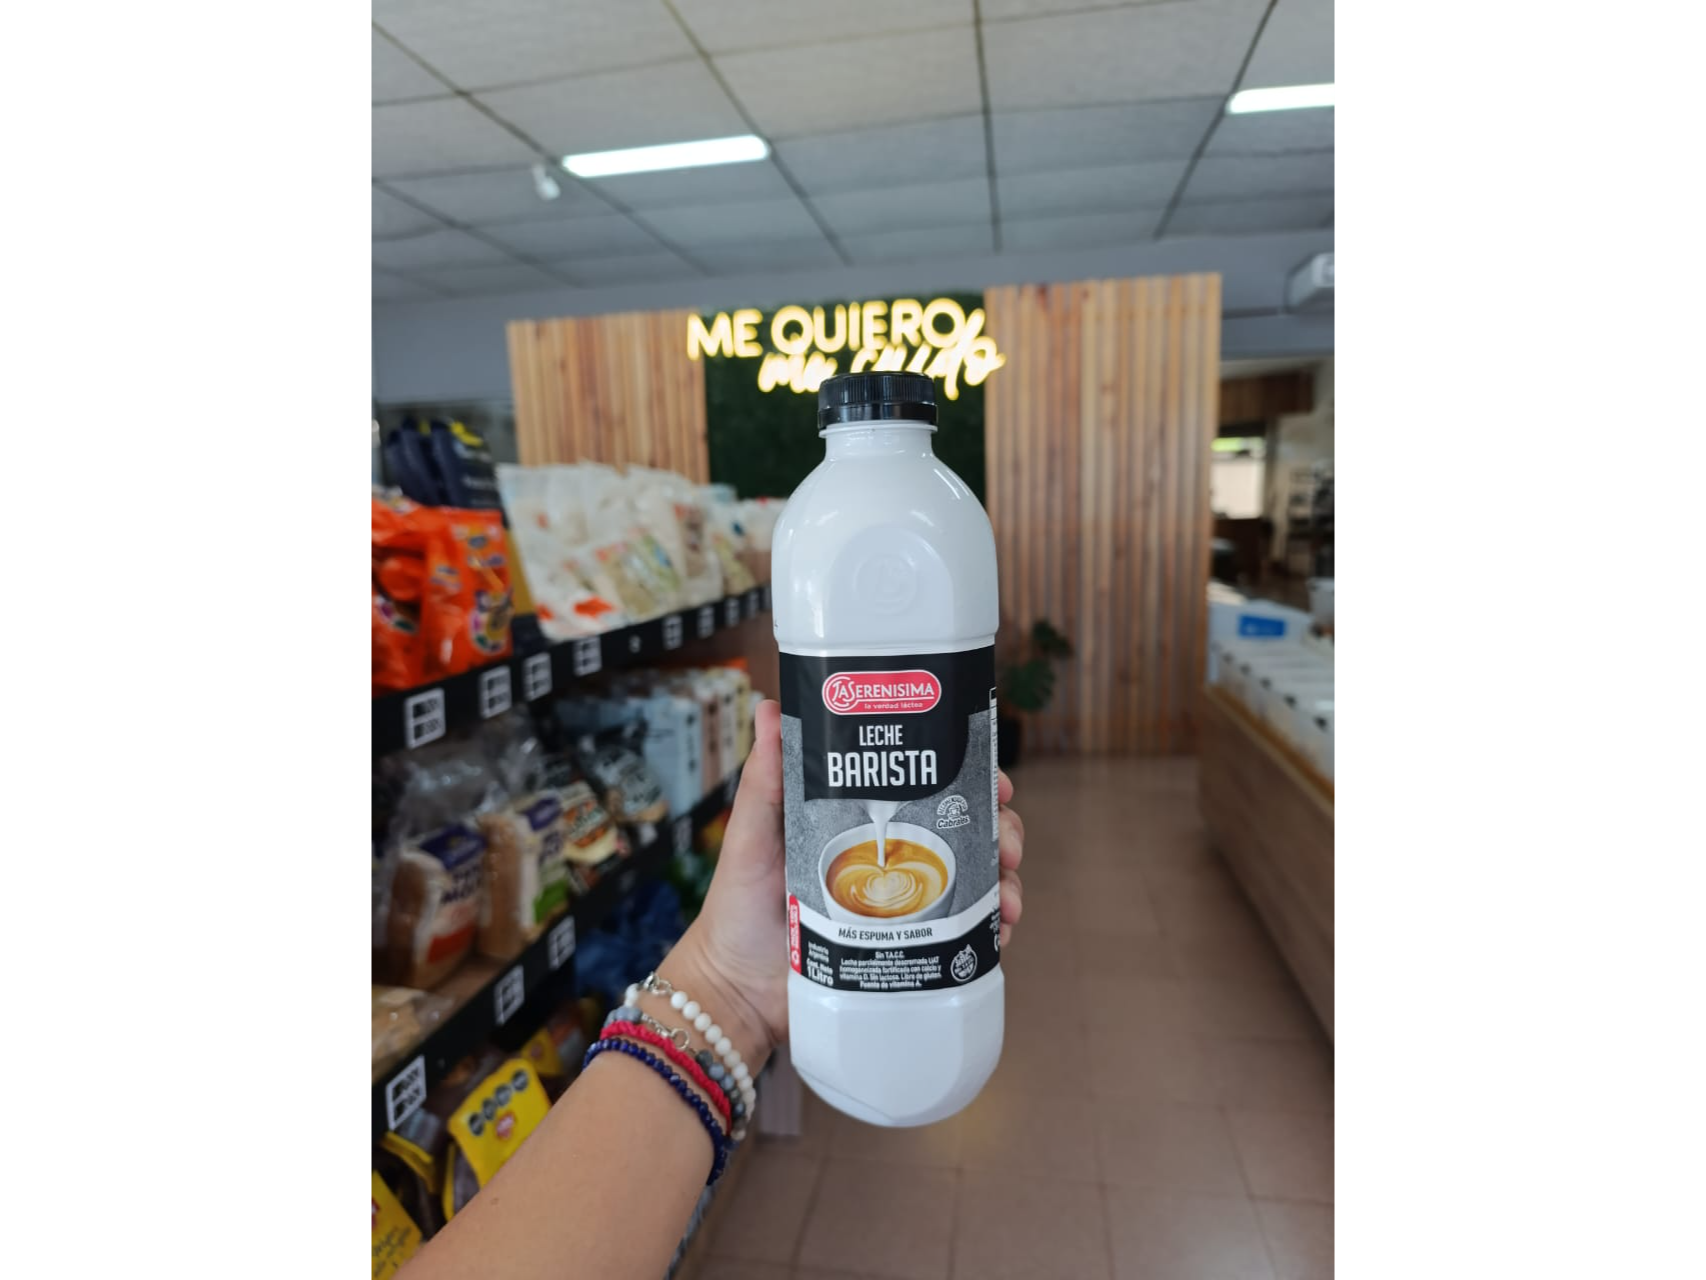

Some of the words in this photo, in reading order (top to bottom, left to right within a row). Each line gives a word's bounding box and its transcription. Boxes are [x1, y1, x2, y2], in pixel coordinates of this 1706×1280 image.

[687, 308, 763, 360] ME
[771, 298, 966, 355] QUIERO
[859, 725, 903, 746] LECHE
[827, 750, 938, 787] BARISTA
[937, 815, 969, 828] Cabrales
[838, 926, 857, 939] MÁS
[859, 930, 895, 941] ESPUMA
[896, 930, 902, 940] Y
[903, 927, 933, 940] SABOR
[875, 951, 885, 959] Sin
[841, 958, 857, 966] Leche
[858, 959, 893, 967] parcialmente
[894, 957, 927, 966] descremada
[901, 972, 915, 980] Libre
[860, 980, 880, 989] Fuente
[881, 981, 888, 989] de
[889, 980, 914, 989] vitamina
